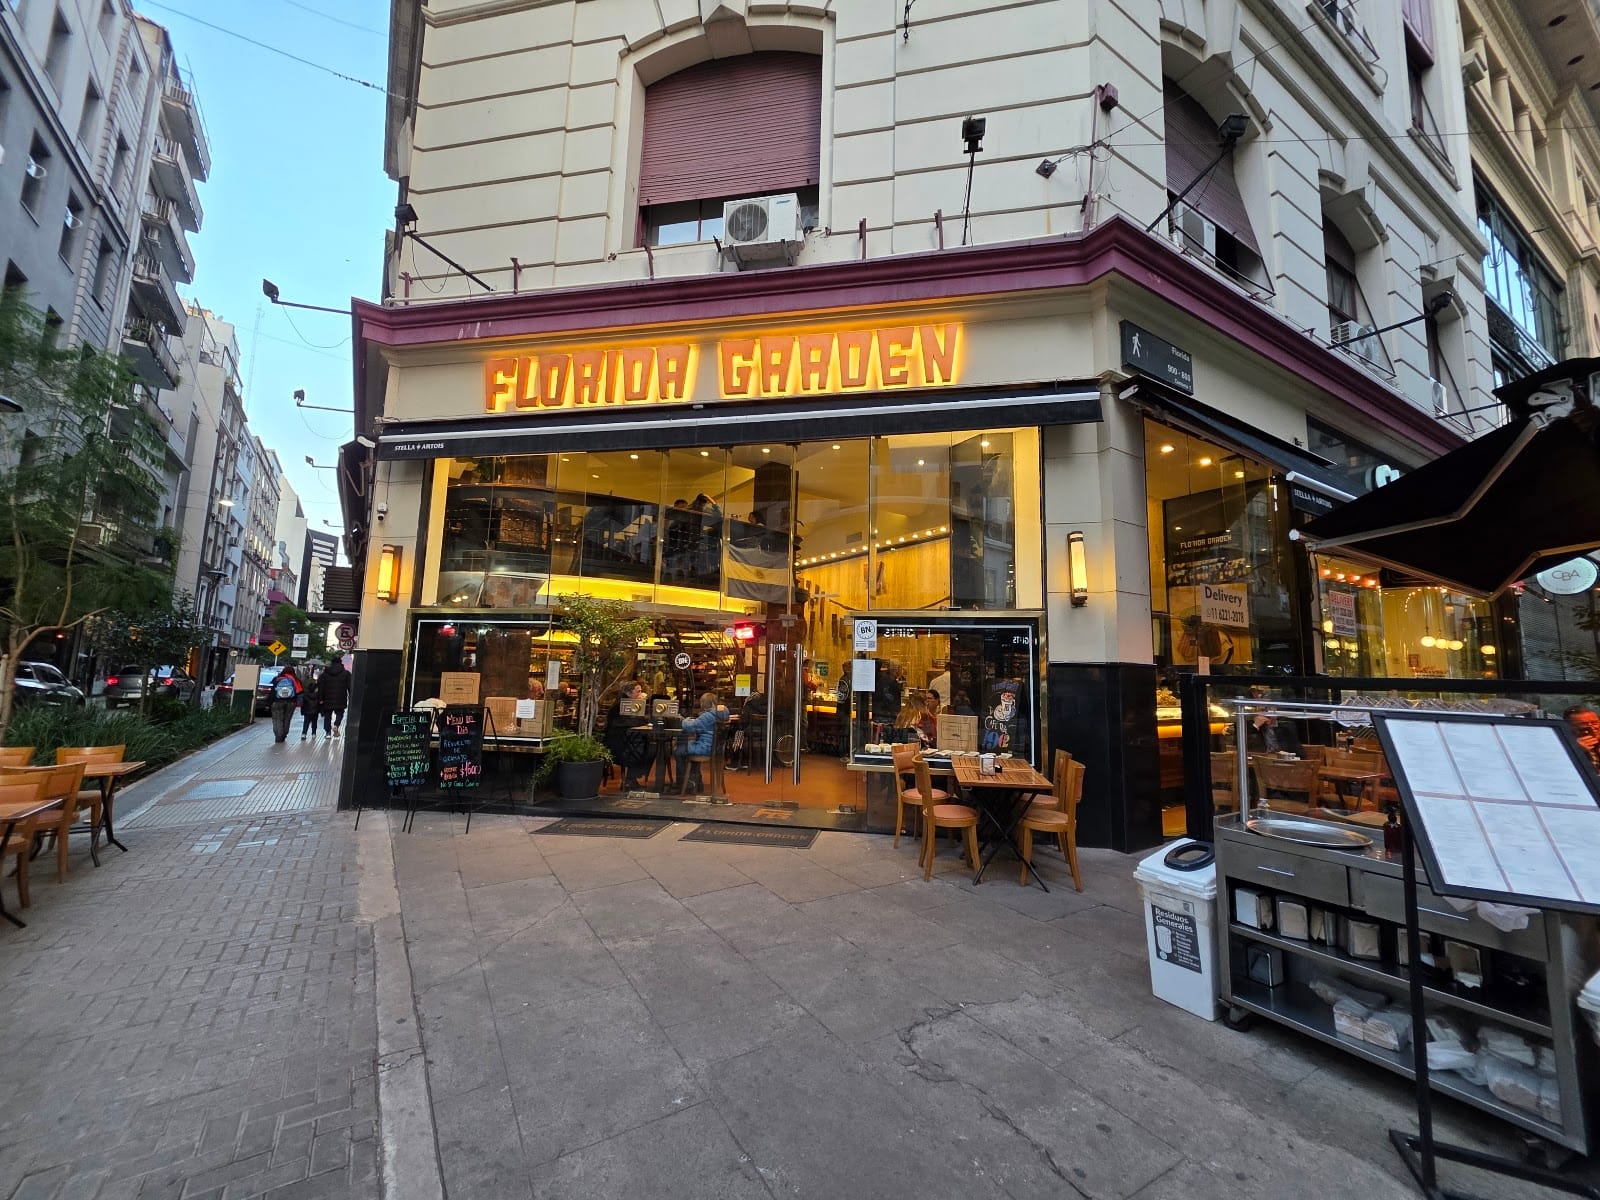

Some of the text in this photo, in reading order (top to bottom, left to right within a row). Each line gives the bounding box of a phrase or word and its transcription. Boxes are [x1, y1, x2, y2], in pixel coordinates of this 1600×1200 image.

[1171, 346, 1190, 362] Florida
[485, 323, 962, 411] FLORIDA GARDEN
[1167, 364, 1178, 376] 900
[421, 442, 445, 450] ARTOIS
[1294, 488, 1312, 501] STELLA
[1551, 569, 1581, 582] CBA
[1204, 585, 1243, 607] Delivery
[1155, 907, 1190, 924] Residuos
[1156, 915, 1193, 933] Generales
